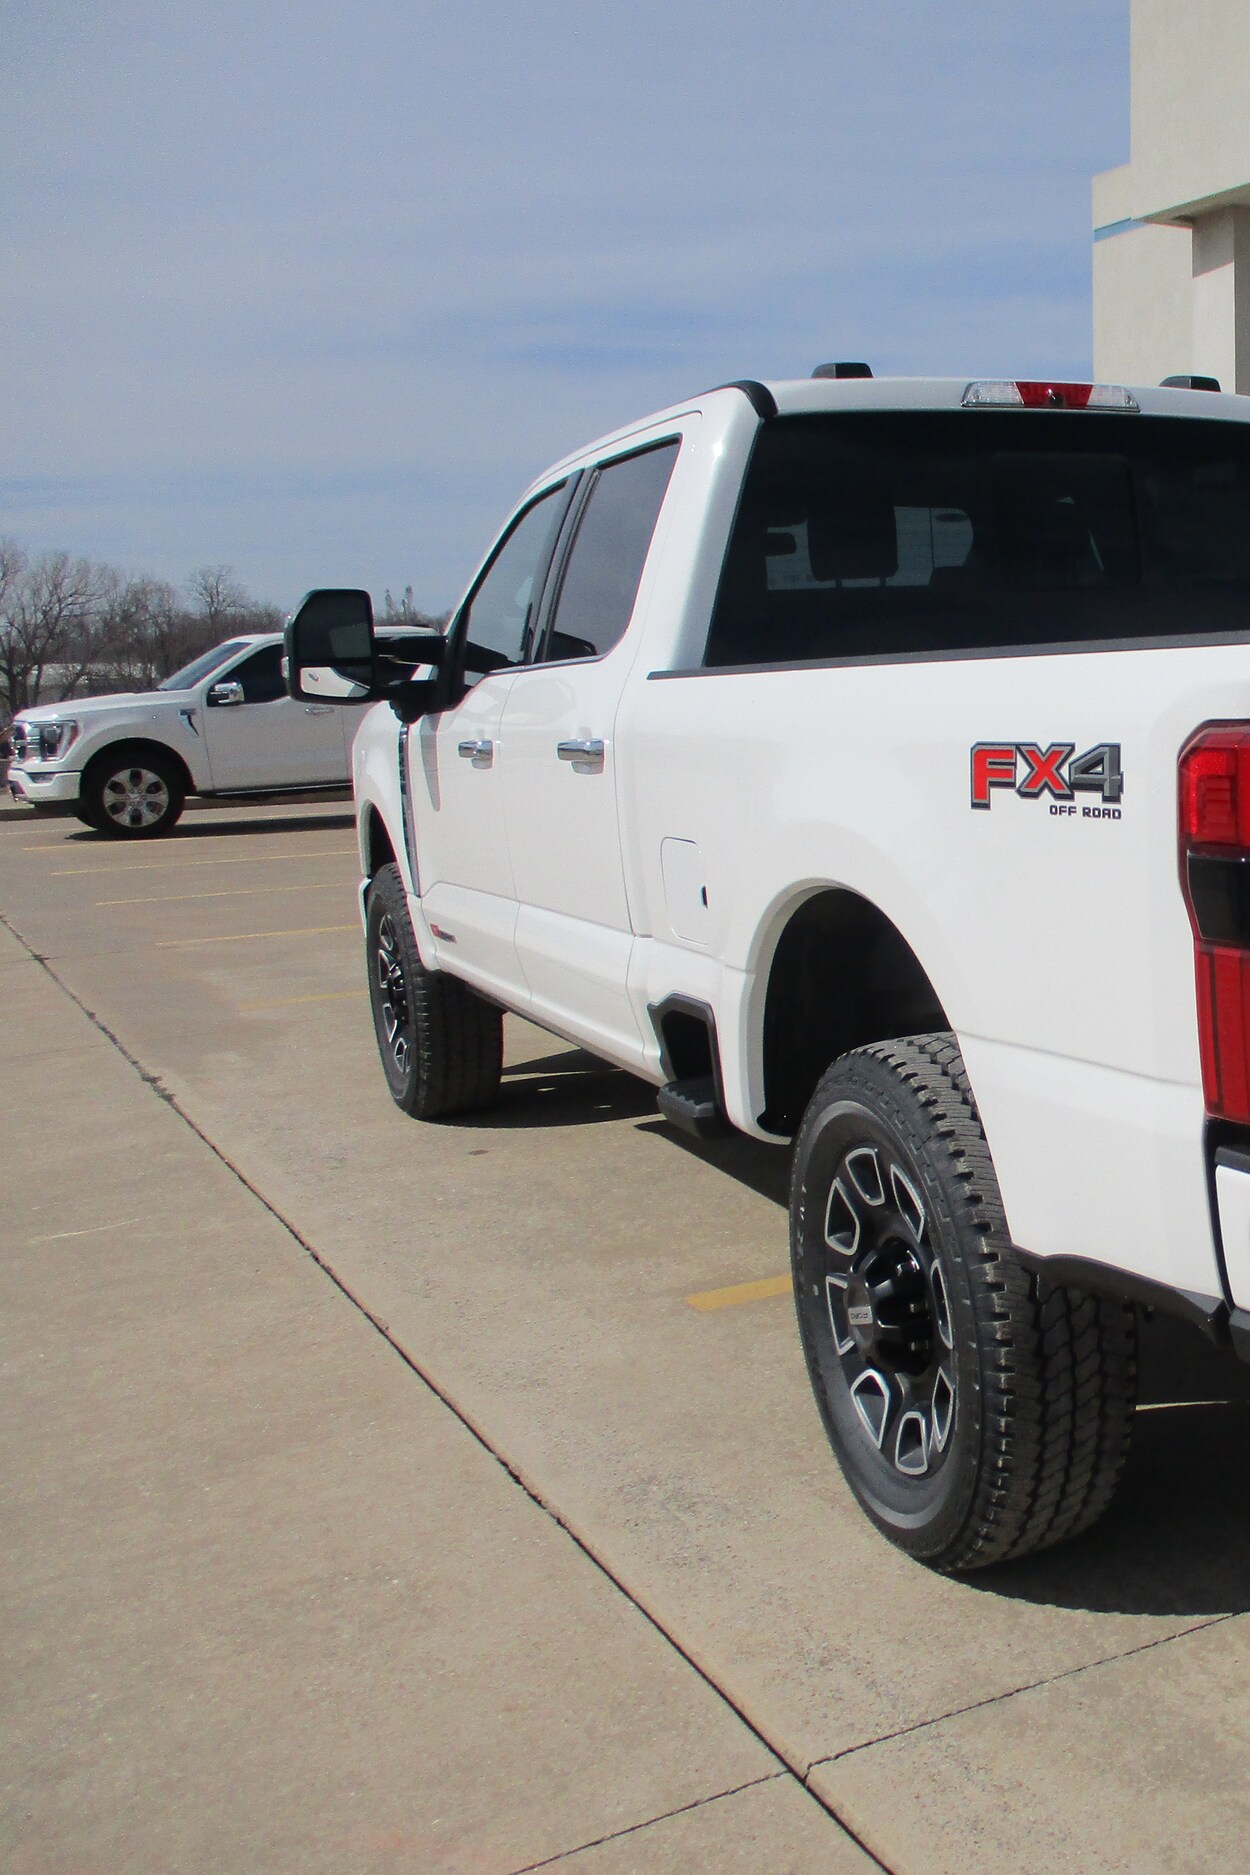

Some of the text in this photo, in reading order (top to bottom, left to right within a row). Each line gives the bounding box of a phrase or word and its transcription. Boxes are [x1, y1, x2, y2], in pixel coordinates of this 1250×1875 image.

[970, 741, 1124, 811] FX4
[1049, 804, 1122, 820] OFF ROAD
